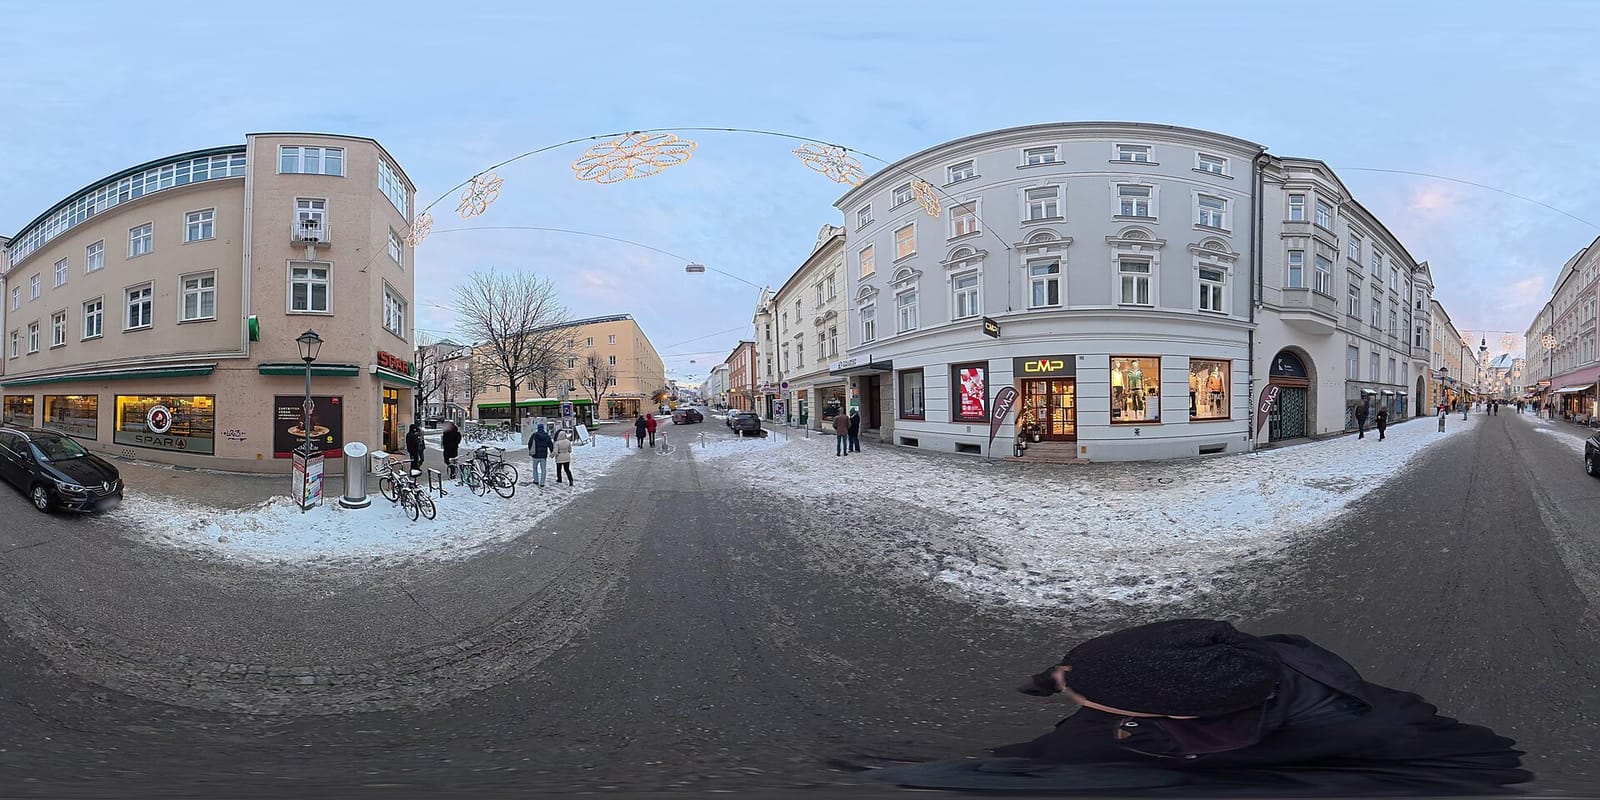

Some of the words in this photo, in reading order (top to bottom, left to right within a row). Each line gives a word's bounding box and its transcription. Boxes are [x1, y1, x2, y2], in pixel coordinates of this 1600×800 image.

[985, 322, 998, 332] CMP
[377, 350, 409, 375] SPAR
[1024, 359, 1064, 373] CMP
[994, 390, 1015, 420] CMP
[1260, 386, 1279, 413] CMP
[135, 435, 174, 447] SPAR
